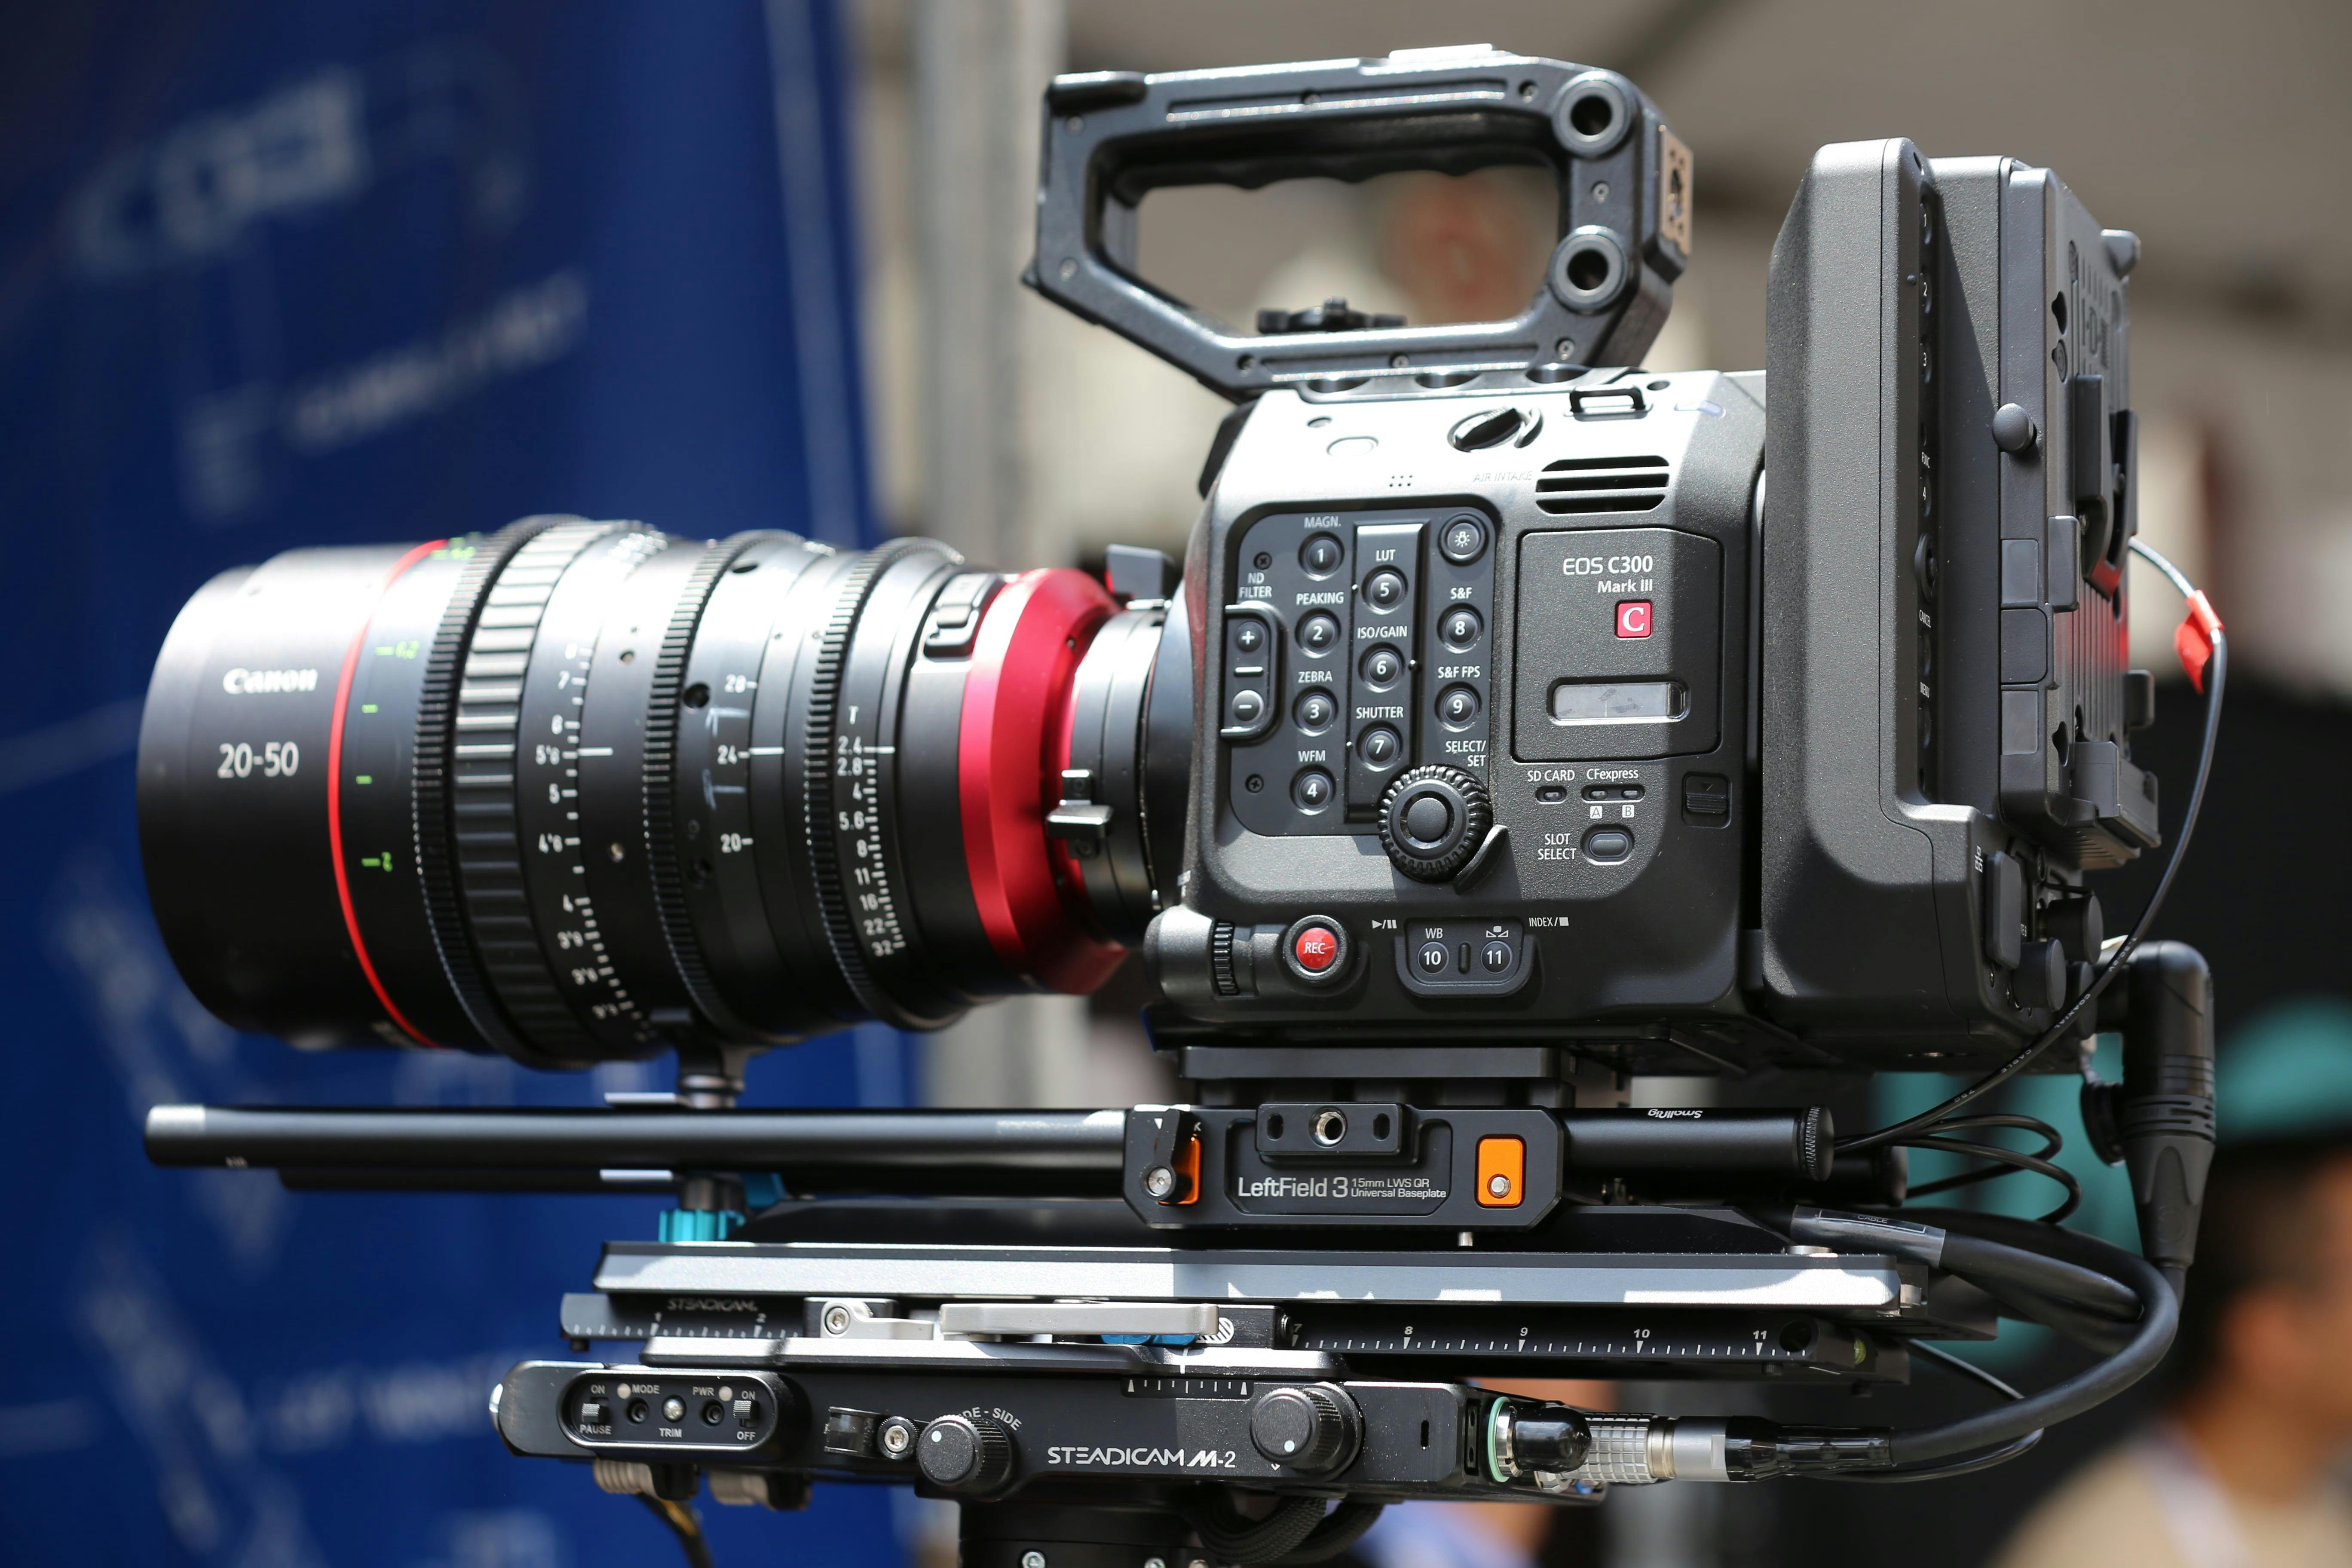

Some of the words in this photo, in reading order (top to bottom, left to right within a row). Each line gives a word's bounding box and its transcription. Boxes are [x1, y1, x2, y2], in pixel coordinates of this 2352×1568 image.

[1923, 214, 1927, 227] 1
[1923, 282, 1928, 297] 2
[1923, 352, 1928, 367] 3
[1473, 472, 1491, 482] AIR
[1494, 471, 1533, 481] INTAKE
[1922, 486, 1926, 501] 4
[1304, 516, 1341, 528] MAGN.
[1317, 548, 1324, 563] 1
[1376, 549, 1396, 562] LUT
[1563, 558, 1604, 576] EOS
[1608, 555, 1653, 575] C300
[1248, 572, 1265, 585] ND
[1239, 586, 1272, 599] FILTER
[1380, 582, 1390, 597] 5
[1451, 587, 1472, 600] S&F
[1598, 580, 1636, 594] Mark
[1640, 579, 1653, 592] III
[1296, 592, 1344, 605] PEAKING
[1622, 606, 1646, 633] C
[1919, 609, 1931, 628] CANCEL
[1313, 626, 1323, 641] 2
[1357, 625, 1408, 639] ISO/GAIN
[1455, 621, 1466, 635] 8
[1377, 660, 1387, 675] 6
[1438, 666, 1459, 679] S&F
[1462, 665, 1481, 678] FPS
[223, 668, 318, 694] Canon
[1298, 671, 1333, 683] ZEBRA
[1920, 681, 1930, 698] MENU
[1310, 704, 1320, 719] 3
[1356, 706, 1404, 719] SHUTTER
[1453, 699, 1463, 714] 9
[848, 705, 859, 725] T
[838, 735, 863, 755] 2.4
[1375, 740, 1384, 754] 7
[1446, 740, 1486, 753] SELECT/
[217, 741, 300, 778] 20-50
[1298, 750, 1326, 763] WFM
[1467, 755, 1486, 767] SET
[837, 756, 863, 776] 2.8
[1527, 770, 1542, 782] SD
[1544, 769, 1576, 782] CARD
[1586, 768, 1639, 781] CFexpress
[852, 781, 863, 801] 4
[1307, 784, 1317, 798] 4
[1592, 806, 1601, 818] A
[839, 811, 864, 830] 5.6
[720, 833, 742, 853] 20
[1545, 833, 1570, 845] SLOT
[856, 839, 868, 858] 8
[1538, 848, 1577, 861] SELECT
[854, 867, 870, 886] 11
[860, 893, 878, 911] 16
[863, 917, 886, 936] 22
[1425, 928, 1443, 939] WB
[1304, 942, 1326, 955] REC
[1424, 950, 1442, 966] 10
[1487, 949, 1503, 965] 11
[2055, 993, 2091, 1028] COAXIAL
[2000, 1049, 2032, 1073] CABLE
[1648, 1109, 1703, 1118] SmallRig
[1238, 1176, 1328, 1197] LeftField
[1332, 1176, 1349, 1198] 3
[1352, 1178, 1385, 1188] 15mm
[1387, 1178, 1412, 1188] LWS
[1413, 1179, 1430, 1188] QR
[1351, 1188, 1396, 1197] Universal
[1398, 1188, 1446, 1200] Baseplate
[756, 1312, 766, 1323] 2
[1404, 1326, 1414, 1335] 8
[1519, 1327, 1528, 1337] 9
[1633, 1329, 1651, 1338] 10
[1752, 1330, 1767, 1340] 11
[591, 1384, 605, 1394] ON
[632, 1384, 660, 1395] MODE
[692, 1386, 715, 1396] PWR
[741, 1390, 756, 1401] ON
[992, 1408, 1022, 1430] SIDE
[580, 1424, 612, 1435] PAUSE
[659, 1427, 683, 1438] TRIM
[736, 1430, 756, 1441] OFF
[1047, 1447, 1185, 1466] STEADICAM
